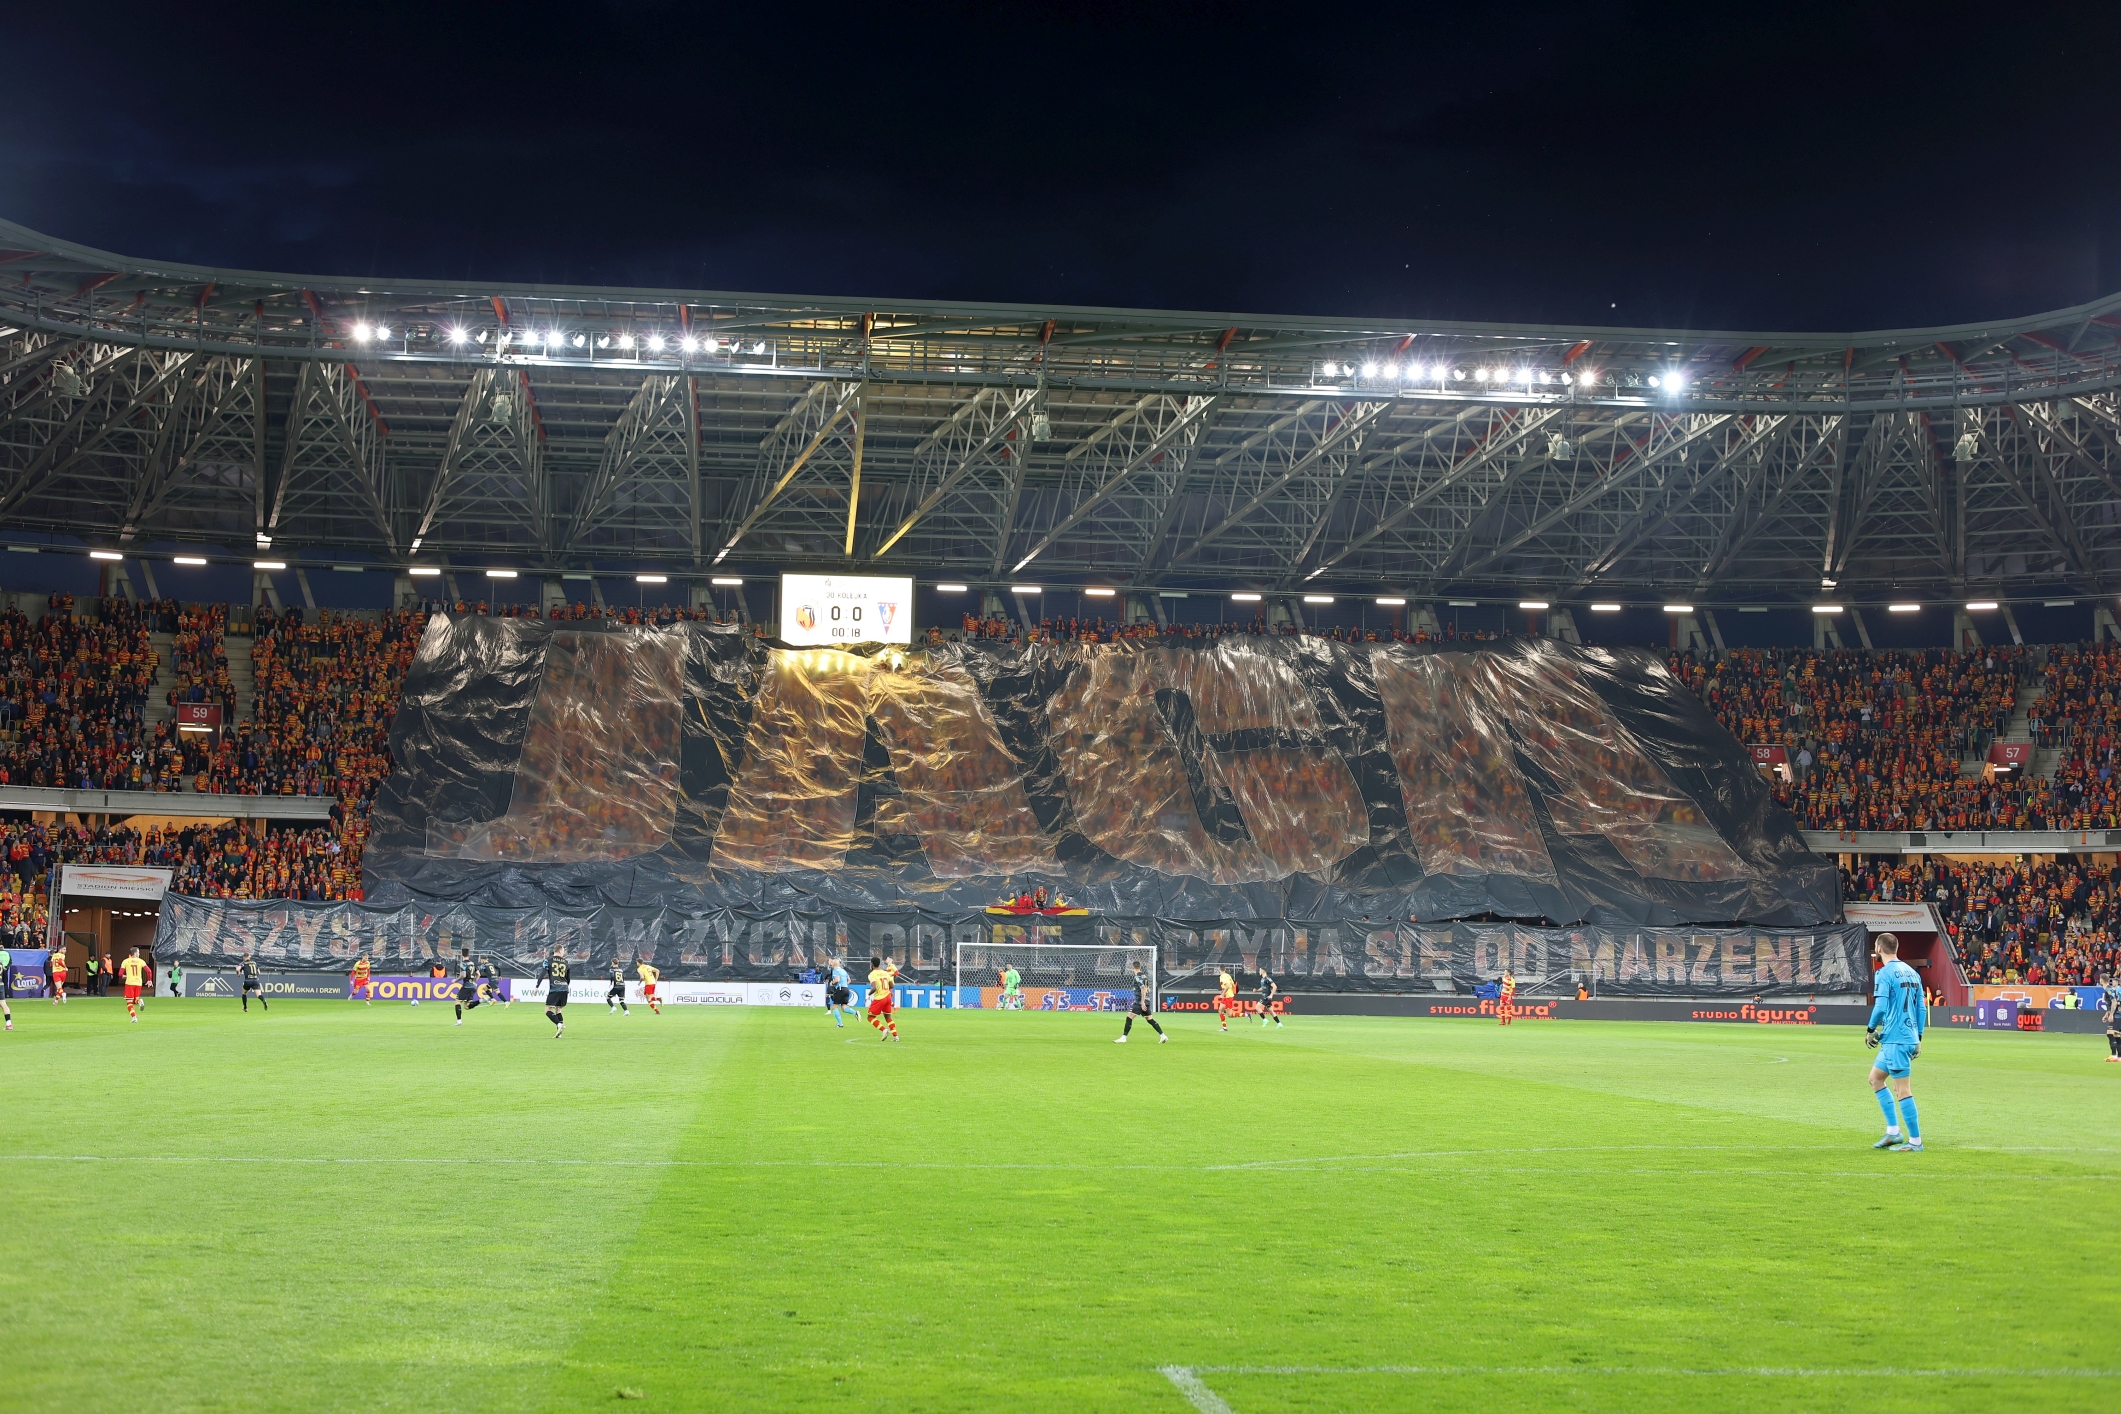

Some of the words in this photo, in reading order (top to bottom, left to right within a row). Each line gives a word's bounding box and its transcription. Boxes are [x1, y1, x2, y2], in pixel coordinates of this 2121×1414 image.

[192, 707, 208, 719] 59
[1756, 748, 1771, 759] 58
[2005, 747, 2020, 758] 57
[173, 903, 476, 959] WSZYSTKO
[513, 917, 592, 964] CO
[613, 916, 664, 963] W
[1475, 931, 1549, 983] OD
[1570, 933, 1851, 985] MARZENIA
[130, 964, 138, 977] 11
[249, 964, 257, 975] 11
[489, 965, 496, 975] 9
[551, 962, 567, 978] 33
[880, 977, 889, 991] 10
[1042, 991, 1071, 1010] STS
[1430, 1006, 1477, 1014] STUDIO
[1692, 1011, 1738, 1019] STUDIO
